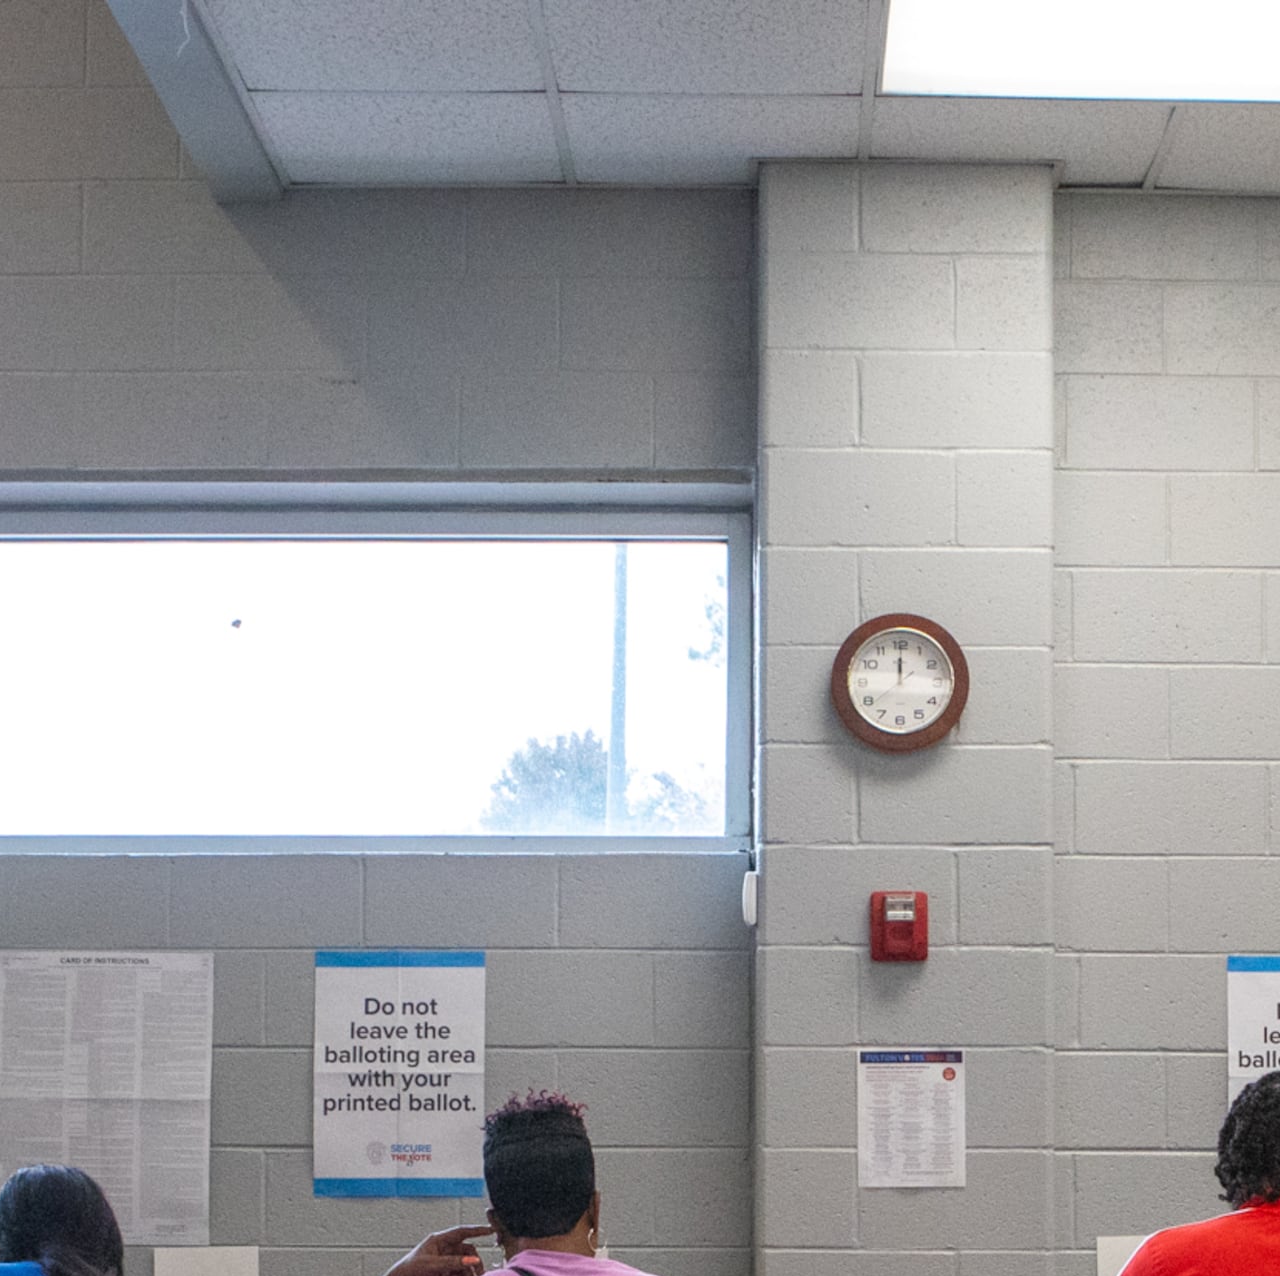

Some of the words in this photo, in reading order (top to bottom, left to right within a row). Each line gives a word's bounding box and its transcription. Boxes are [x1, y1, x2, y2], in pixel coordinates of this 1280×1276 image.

[892, 640, 908, 650] 12
[876, 646, 885, 656] 11
[863, 660, 878, 670] 10
[926, 660, 937, 670] 2
[857, 678, 868, 688] 9
[933, 677, 942, 688] 3
[863, 696, 874, 706] 8
[926, 696, 937, 706] 4
[877, 709, 887, 719] 7
[913, 709, 924, 720] 5
[895, 716, 905, 726] 6
[60, 957, 81, 965] CARD
[83, 957, 93, 965] OF
[94, 957, 150, 965] INSTRUCTIONS
[364, 998, 395, 1016] Do
[402, 998, 438, 1016] not
[350, 1021, 408, 1039] leave
[414, 1021, 451, 1039] the
[324, 1046, 420, 1067] balloting
[427, 1049, 476, 1064] area
[348, 1070, 395, 1087] with
[401, 1073, 452, 1091] your
[323, 1093, 401, 1116] printed
[409, 1093, 477, 1112] ballot.
[390, 1144, 432, 1153] SECURE
[391, 1154, 407, 1162] THE
